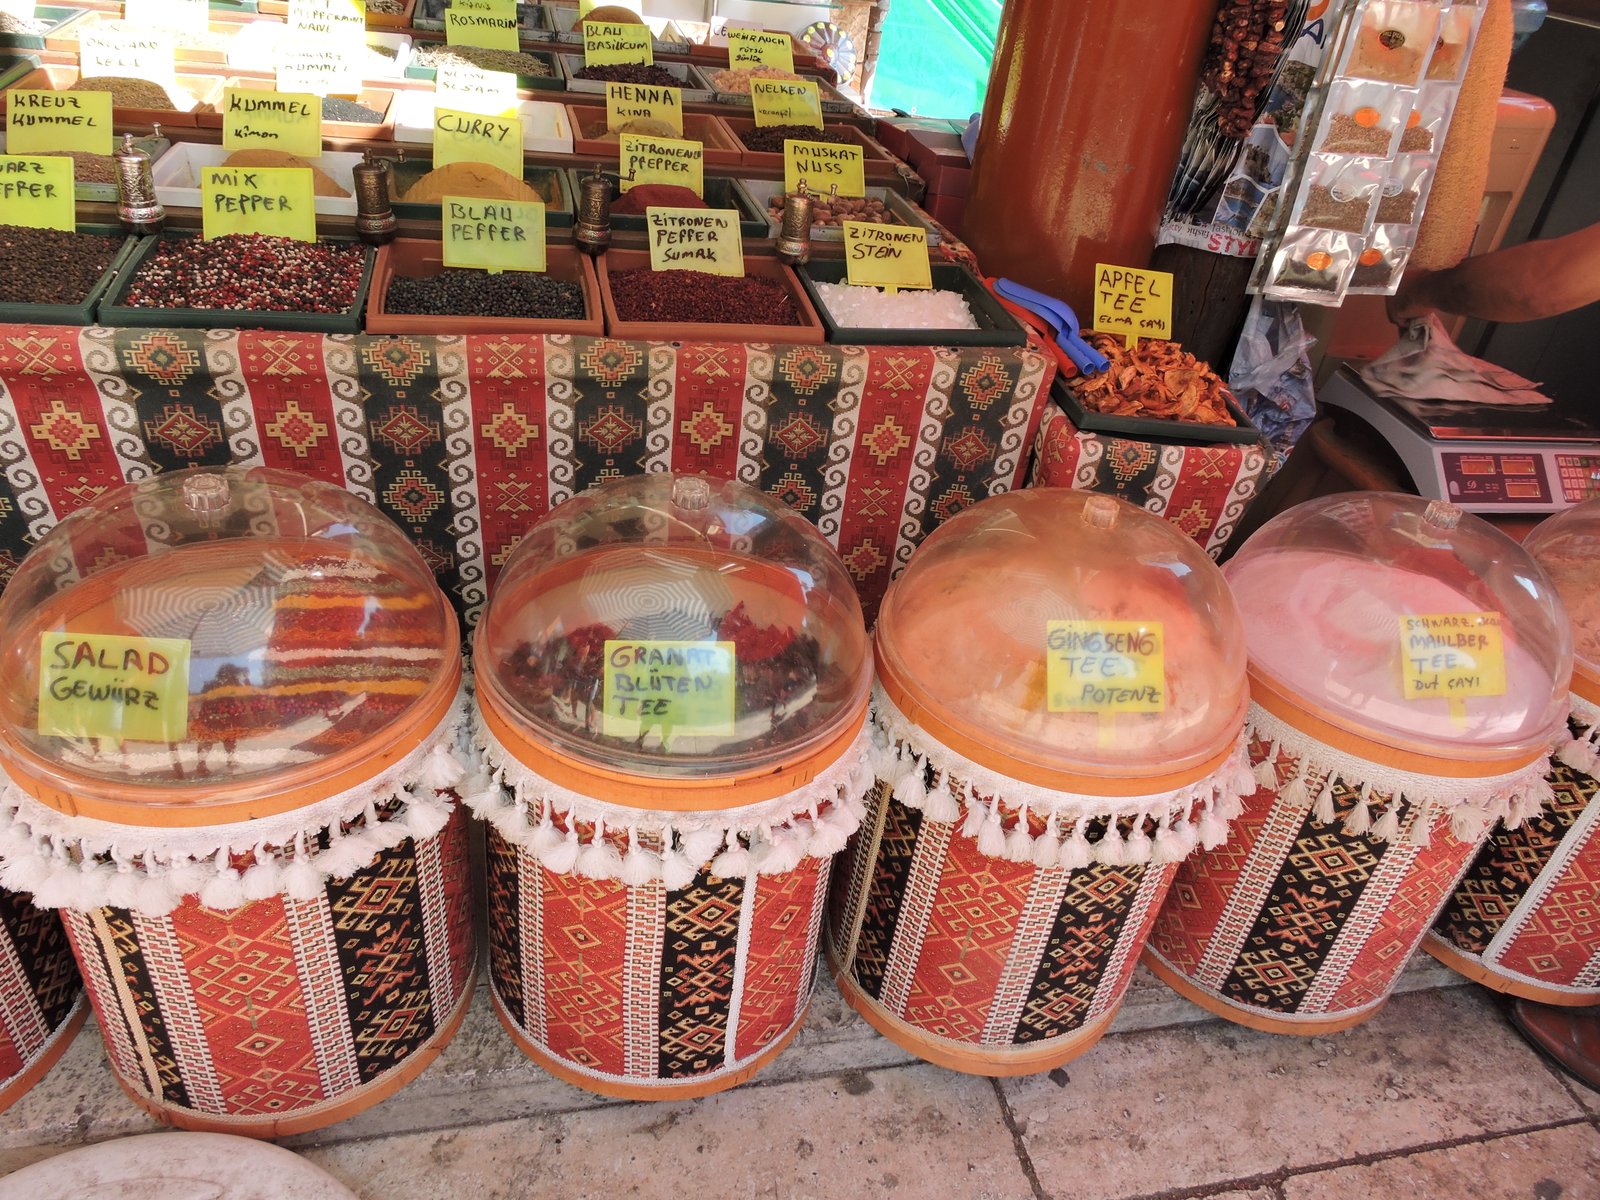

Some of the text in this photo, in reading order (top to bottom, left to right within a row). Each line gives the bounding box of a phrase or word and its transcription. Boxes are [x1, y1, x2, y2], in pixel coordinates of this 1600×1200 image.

[586, 25, 622, 36] BLAU
[611, 87, 674, 105] HENNA
[754, 83, 807, 96] NELKEN
[14, 94, 82, 109] KREUZ
[437, 114, 509, 142] CURRY
[793, 144, 858, 161] MUSKAT
[796, 159, 843, 175] NUSS
[214, 193, 293, 216] PEPPER
[450, 202, 513, 222] BLAU
[451, 222, 527, 242] PEFFER
[656, 229, 719, 247] PEFFER
[1099, 269, 1161, 298] APFEL
[1100, 290, 1147, 313] TEE
[1099, 315, 1133, 325] ELMA
[50, 641, 170, 675] SALAD
[610, 645, 717, 668] GRANAT
[1410, 653, 1457, 675] TEE
[1060, 656, 1119, 678] TEE
[1081, 684, 1161, 704] POTENZ
[612, 695, 672, 715] TEE
